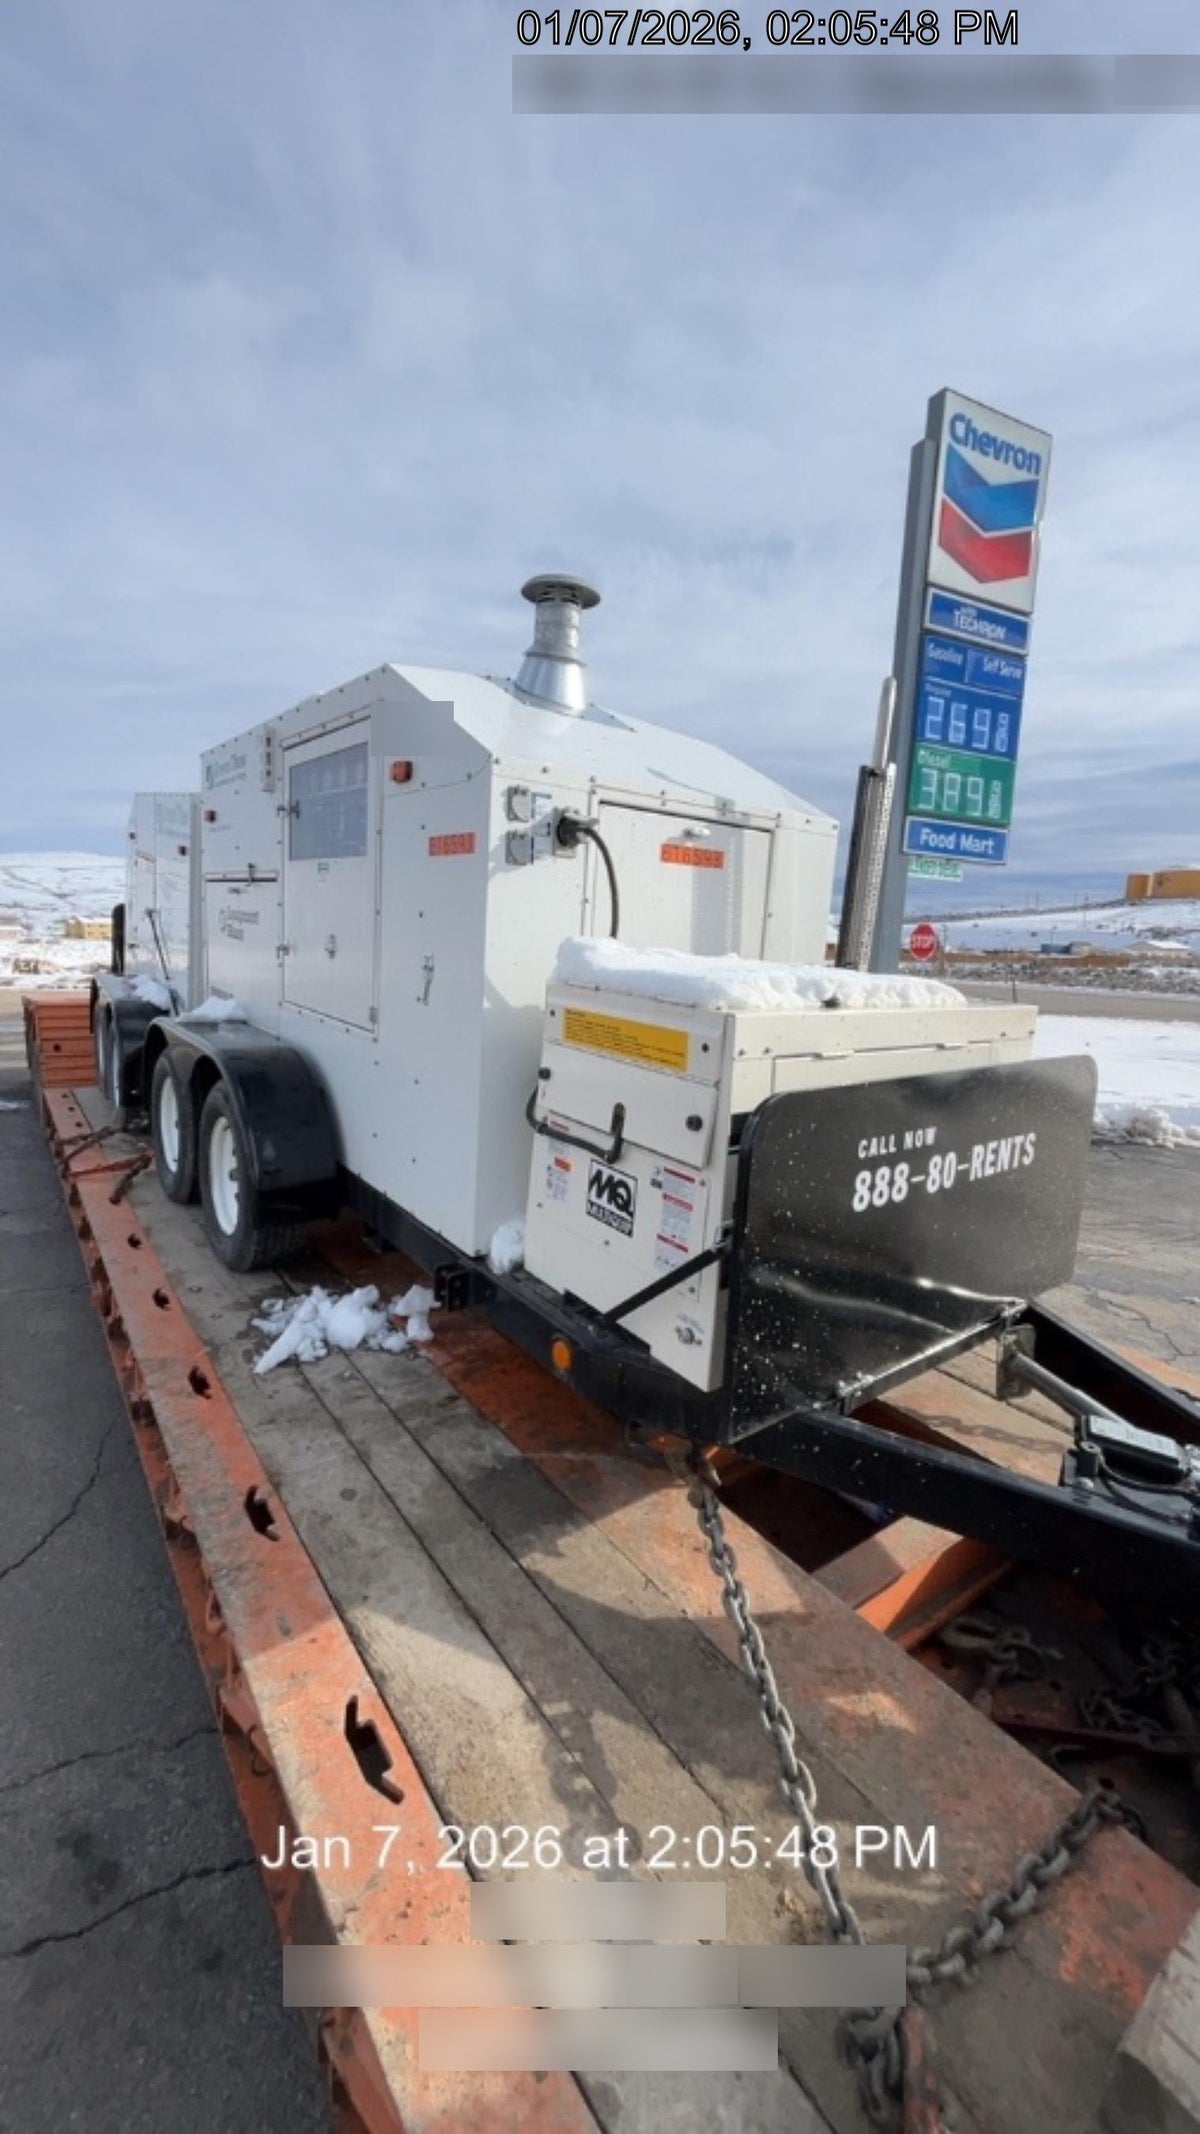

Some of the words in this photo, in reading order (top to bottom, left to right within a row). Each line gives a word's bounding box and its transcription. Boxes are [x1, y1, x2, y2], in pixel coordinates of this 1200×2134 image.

[949, 412, 1041, 477] Chevron
[917, 750, 951, 769] Diesel
[919, 827, 956, 851] Food
[959, 832, 995, 855] Mart
[858, 1134, 897, 1159] CALL
[903, 1126, 938, 1150] NOW
[853, 1132, 1037, 1212] 888-80-RENTS
